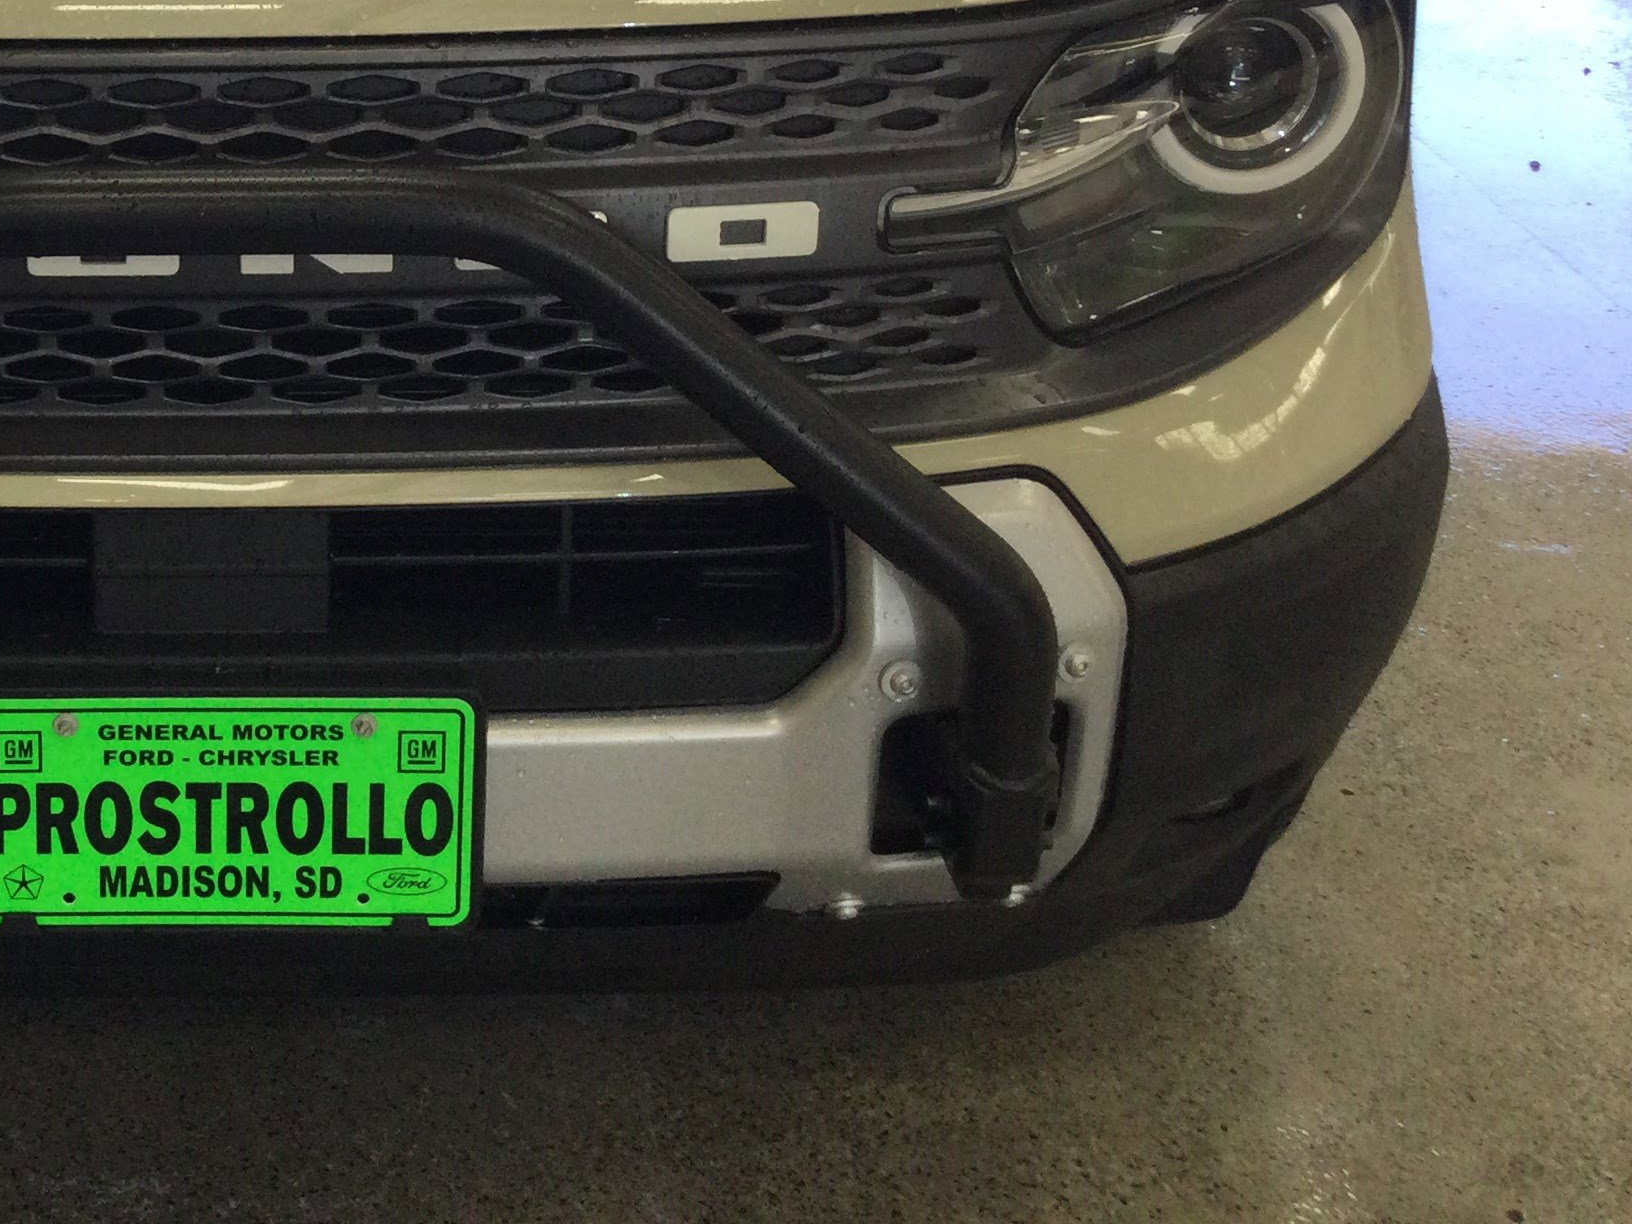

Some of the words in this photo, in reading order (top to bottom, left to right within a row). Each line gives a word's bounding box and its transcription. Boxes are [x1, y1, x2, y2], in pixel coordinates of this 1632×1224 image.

[98, 724, 223, 741] GENERAL
[232, 724, 344, 741] MOTORS
[4, 739, 33, 759] GM
[103, 749, 173, 766] FORD
[198, 749, 339, 766] CHRYSLER
[407, 739, 437, 759] GM
[99, 865, 281, 904] MADISON,
[294, 865, 343, 899] SD
[382, 872, 433, 889] Ford
